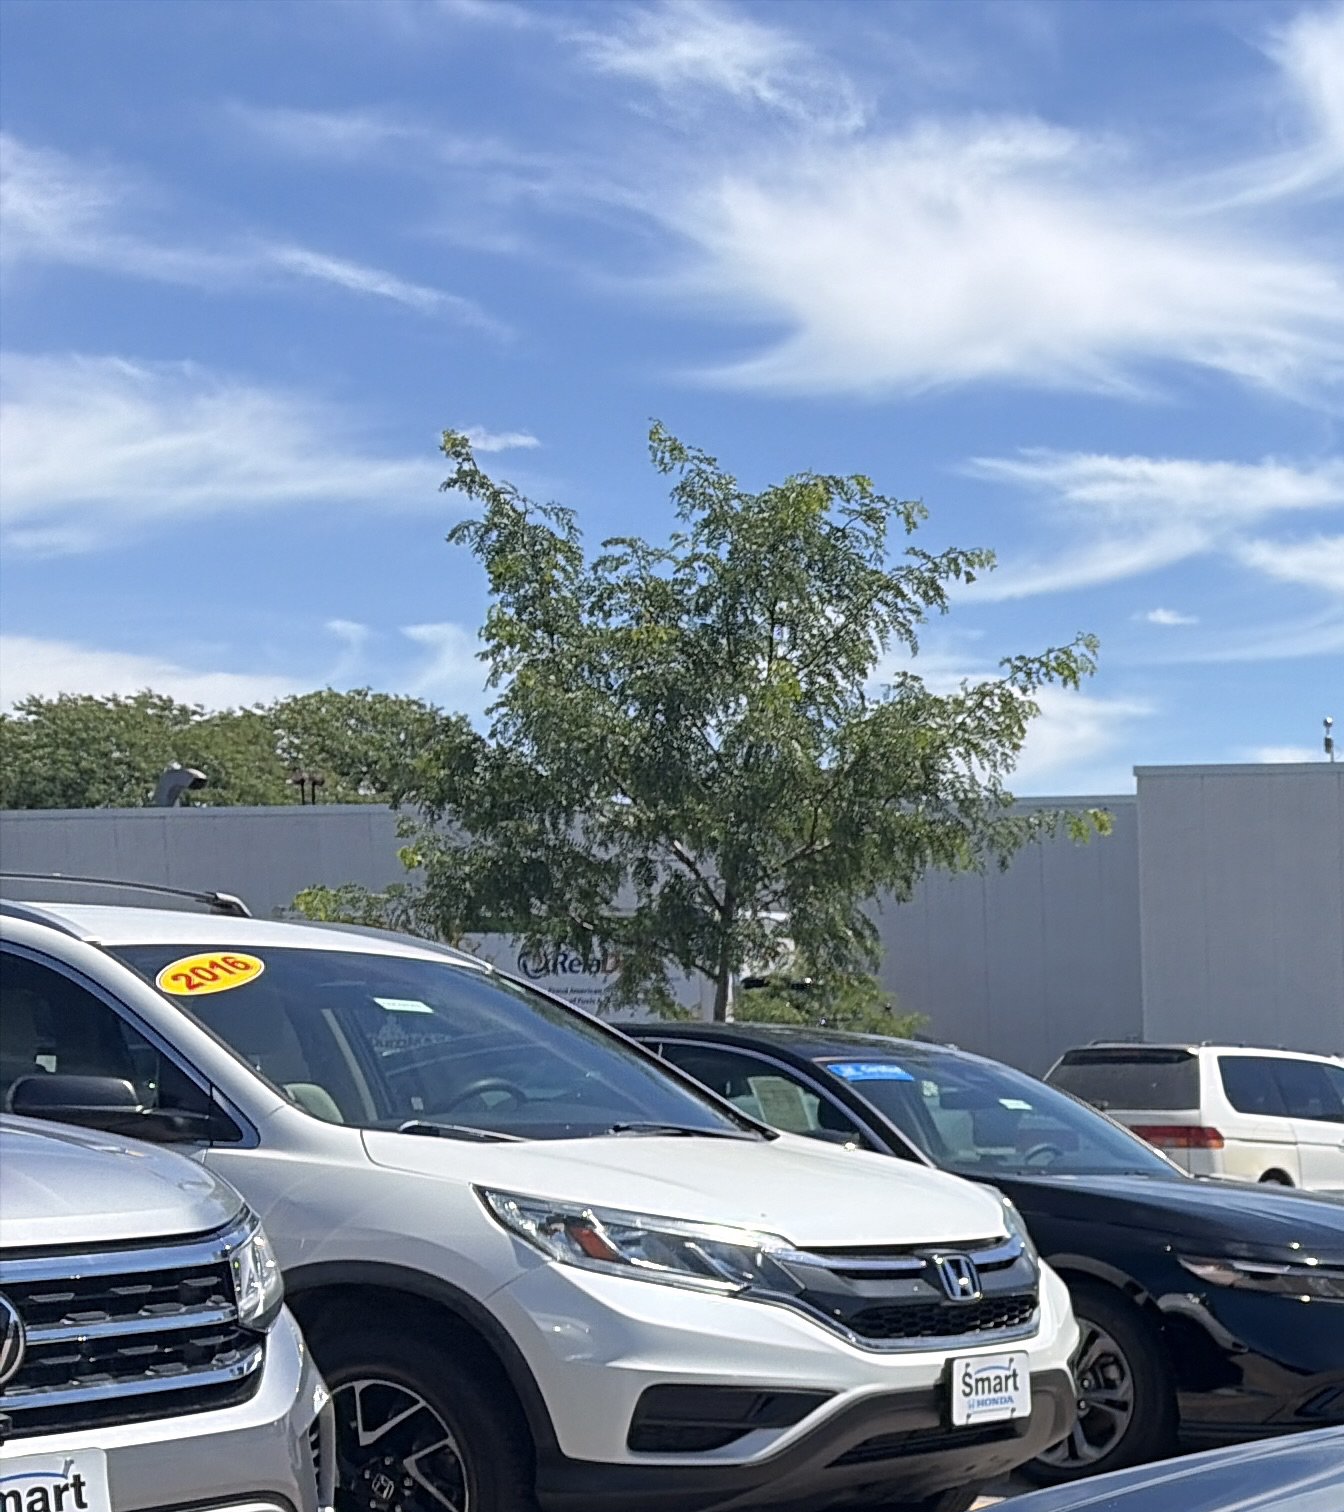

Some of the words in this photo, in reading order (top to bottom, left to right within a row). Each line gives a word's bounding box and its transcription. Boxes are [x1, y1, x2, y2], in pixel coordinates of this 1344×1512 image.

[171, 956, 251, 991] 2016
[961, 1368, 1020, 1397] Smart
[976, 1396, 1015, 1408] HONDA
